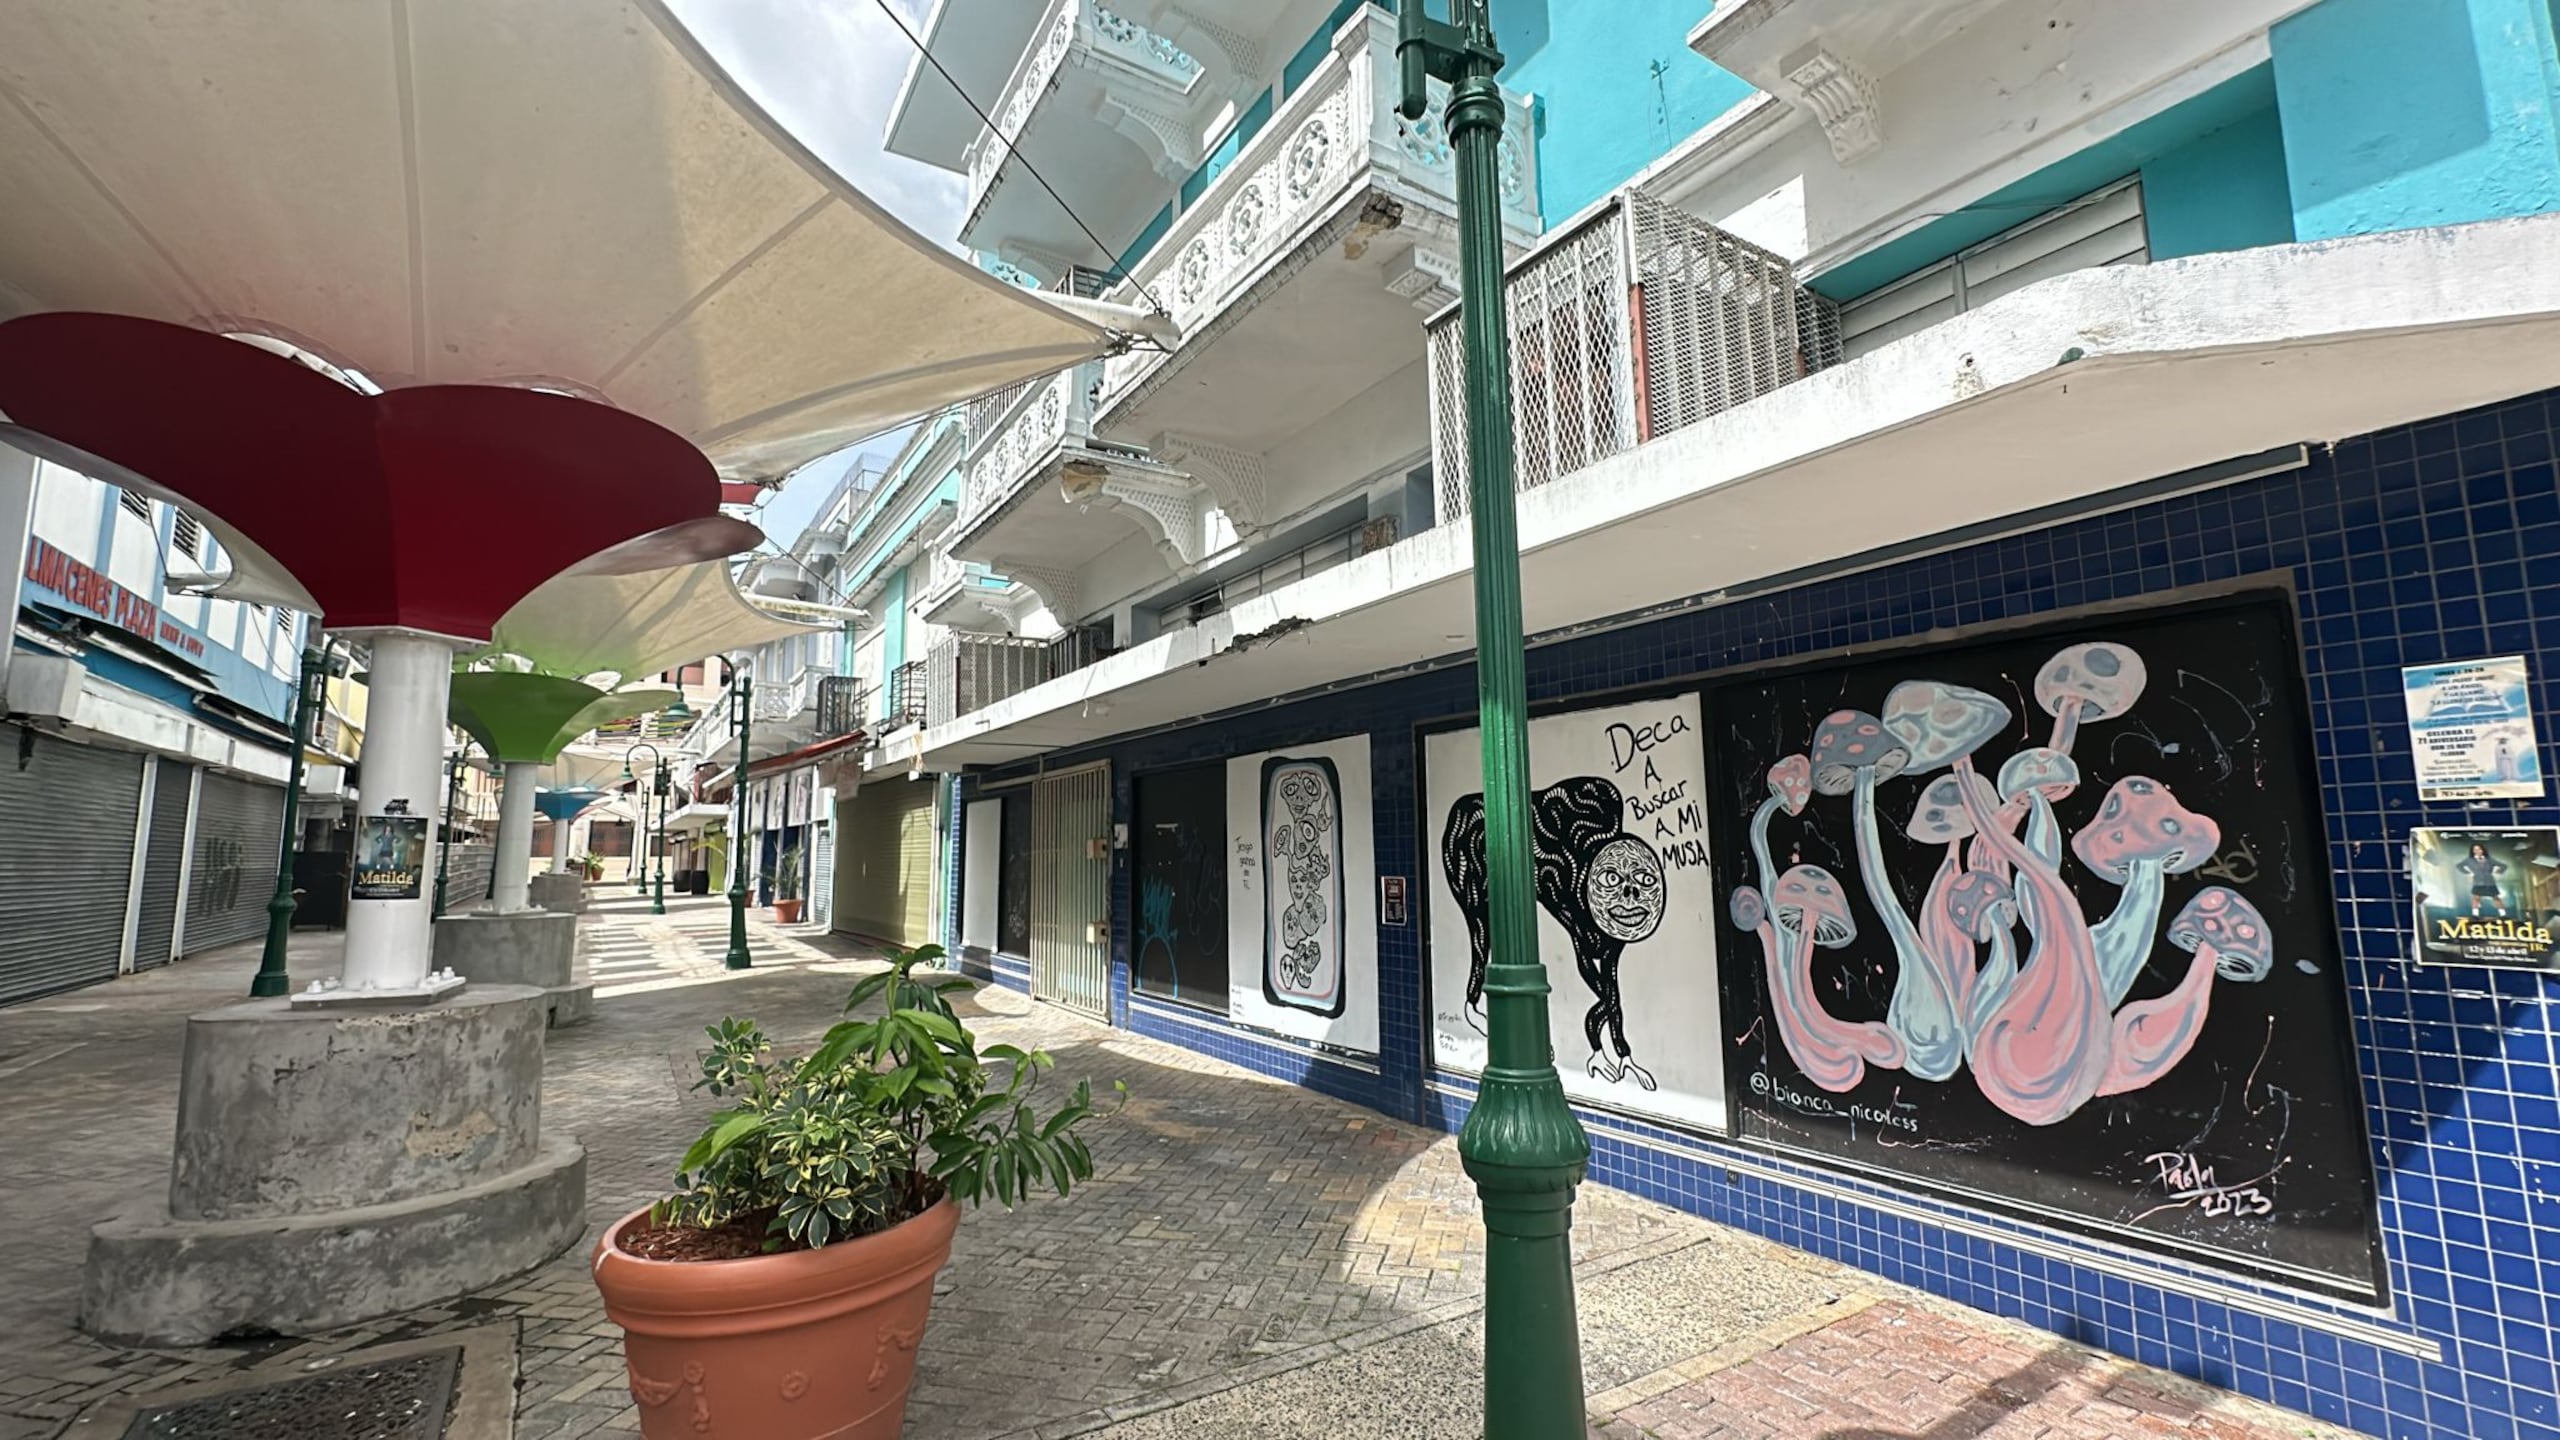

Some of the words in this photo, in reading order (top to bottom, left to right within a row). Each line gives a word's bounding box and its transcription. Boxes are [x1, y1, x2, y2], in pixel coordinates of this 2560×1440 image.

[26, 535, 114, 620] LMACENES
[115, 584, 158, 642] PLAZA
[1605, 715, 1691, 774] Deca
[1644, 754, 1662, 790] A
[1625, 779, 1688, 822] Buscar
[1655, 817, 1676, 841] A
[1662, 839, 1710, 870] MUSA
[358, 870, 414, 885] Matilda
[2437, 917, 2554, 944] Matilda
[2201, 1188, 2272, 1217] 2023
